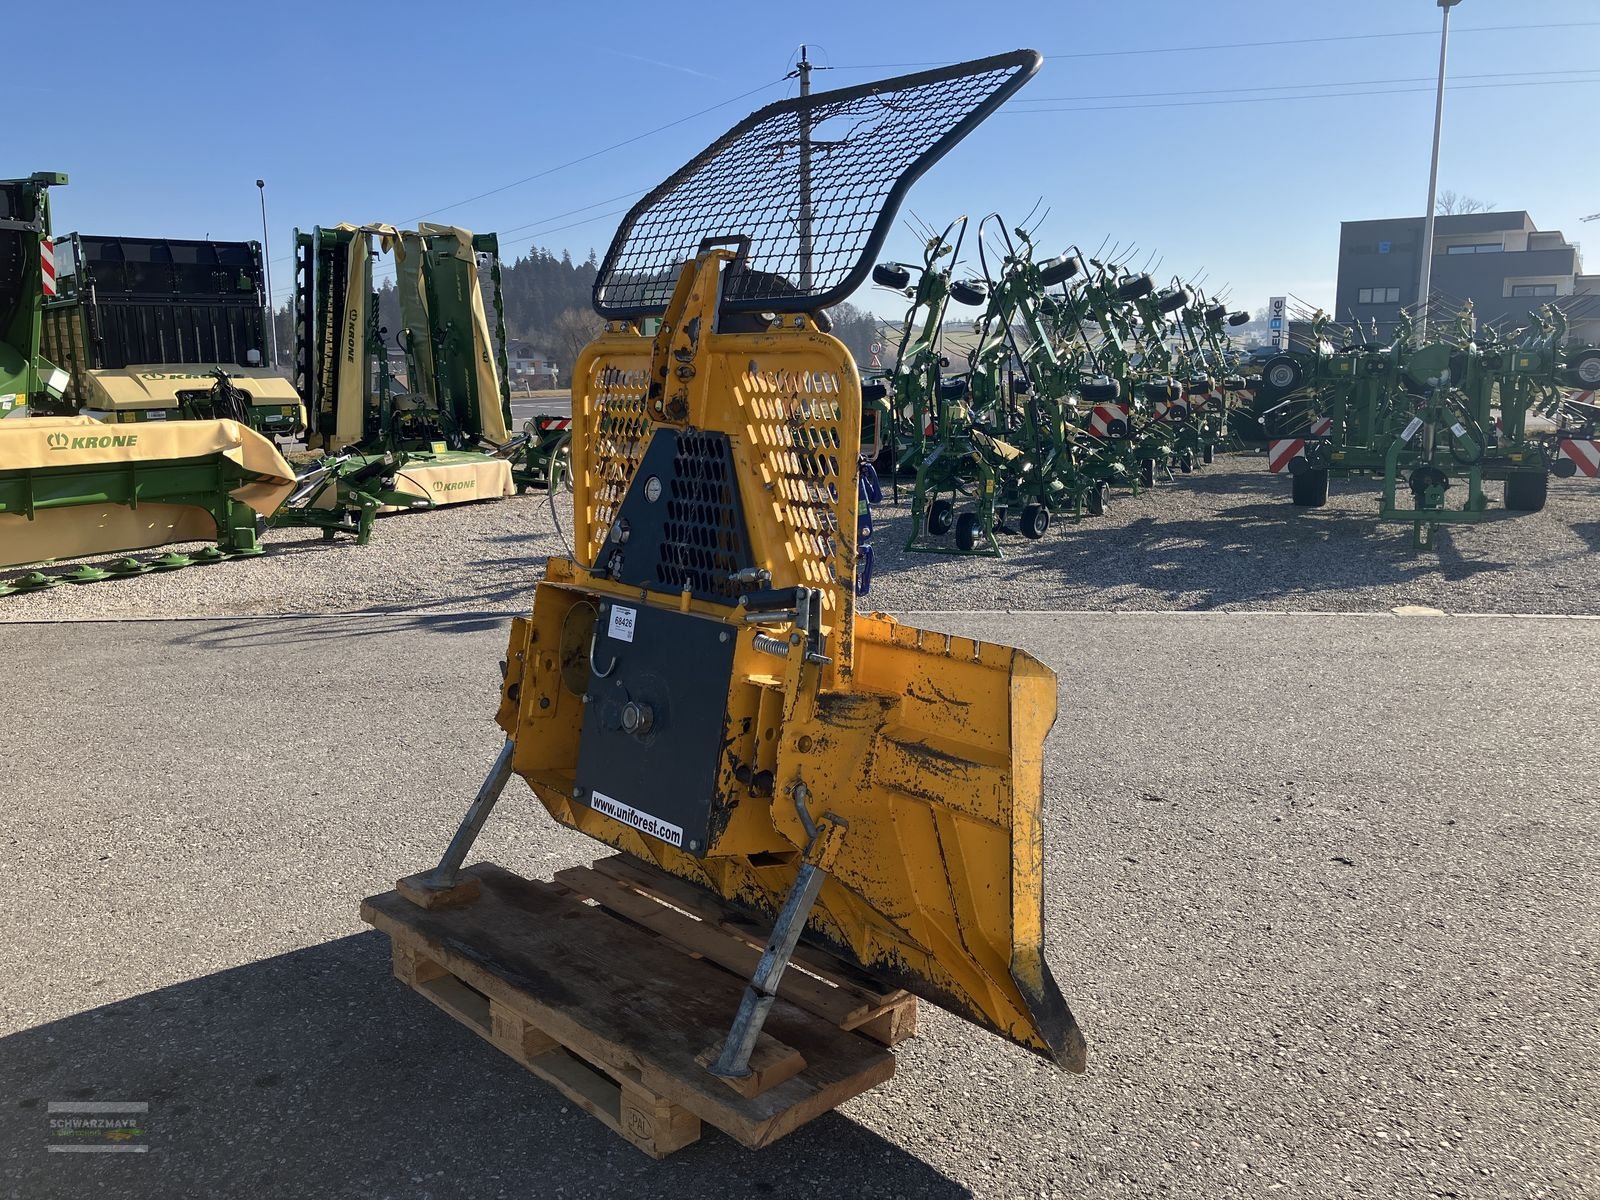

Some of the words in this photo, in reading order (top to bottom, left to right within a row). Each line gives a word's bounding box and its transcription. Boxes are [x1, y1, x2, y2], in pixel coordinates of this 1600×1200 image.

[347, 322, 356, 364] KRONE
[71, 434, 138, 450] KRONE
[443, 480, 476, 492] KRONE
[614, 616, 633, 628] 68426
[593, 796, 681, 844] www.uniforest.com
